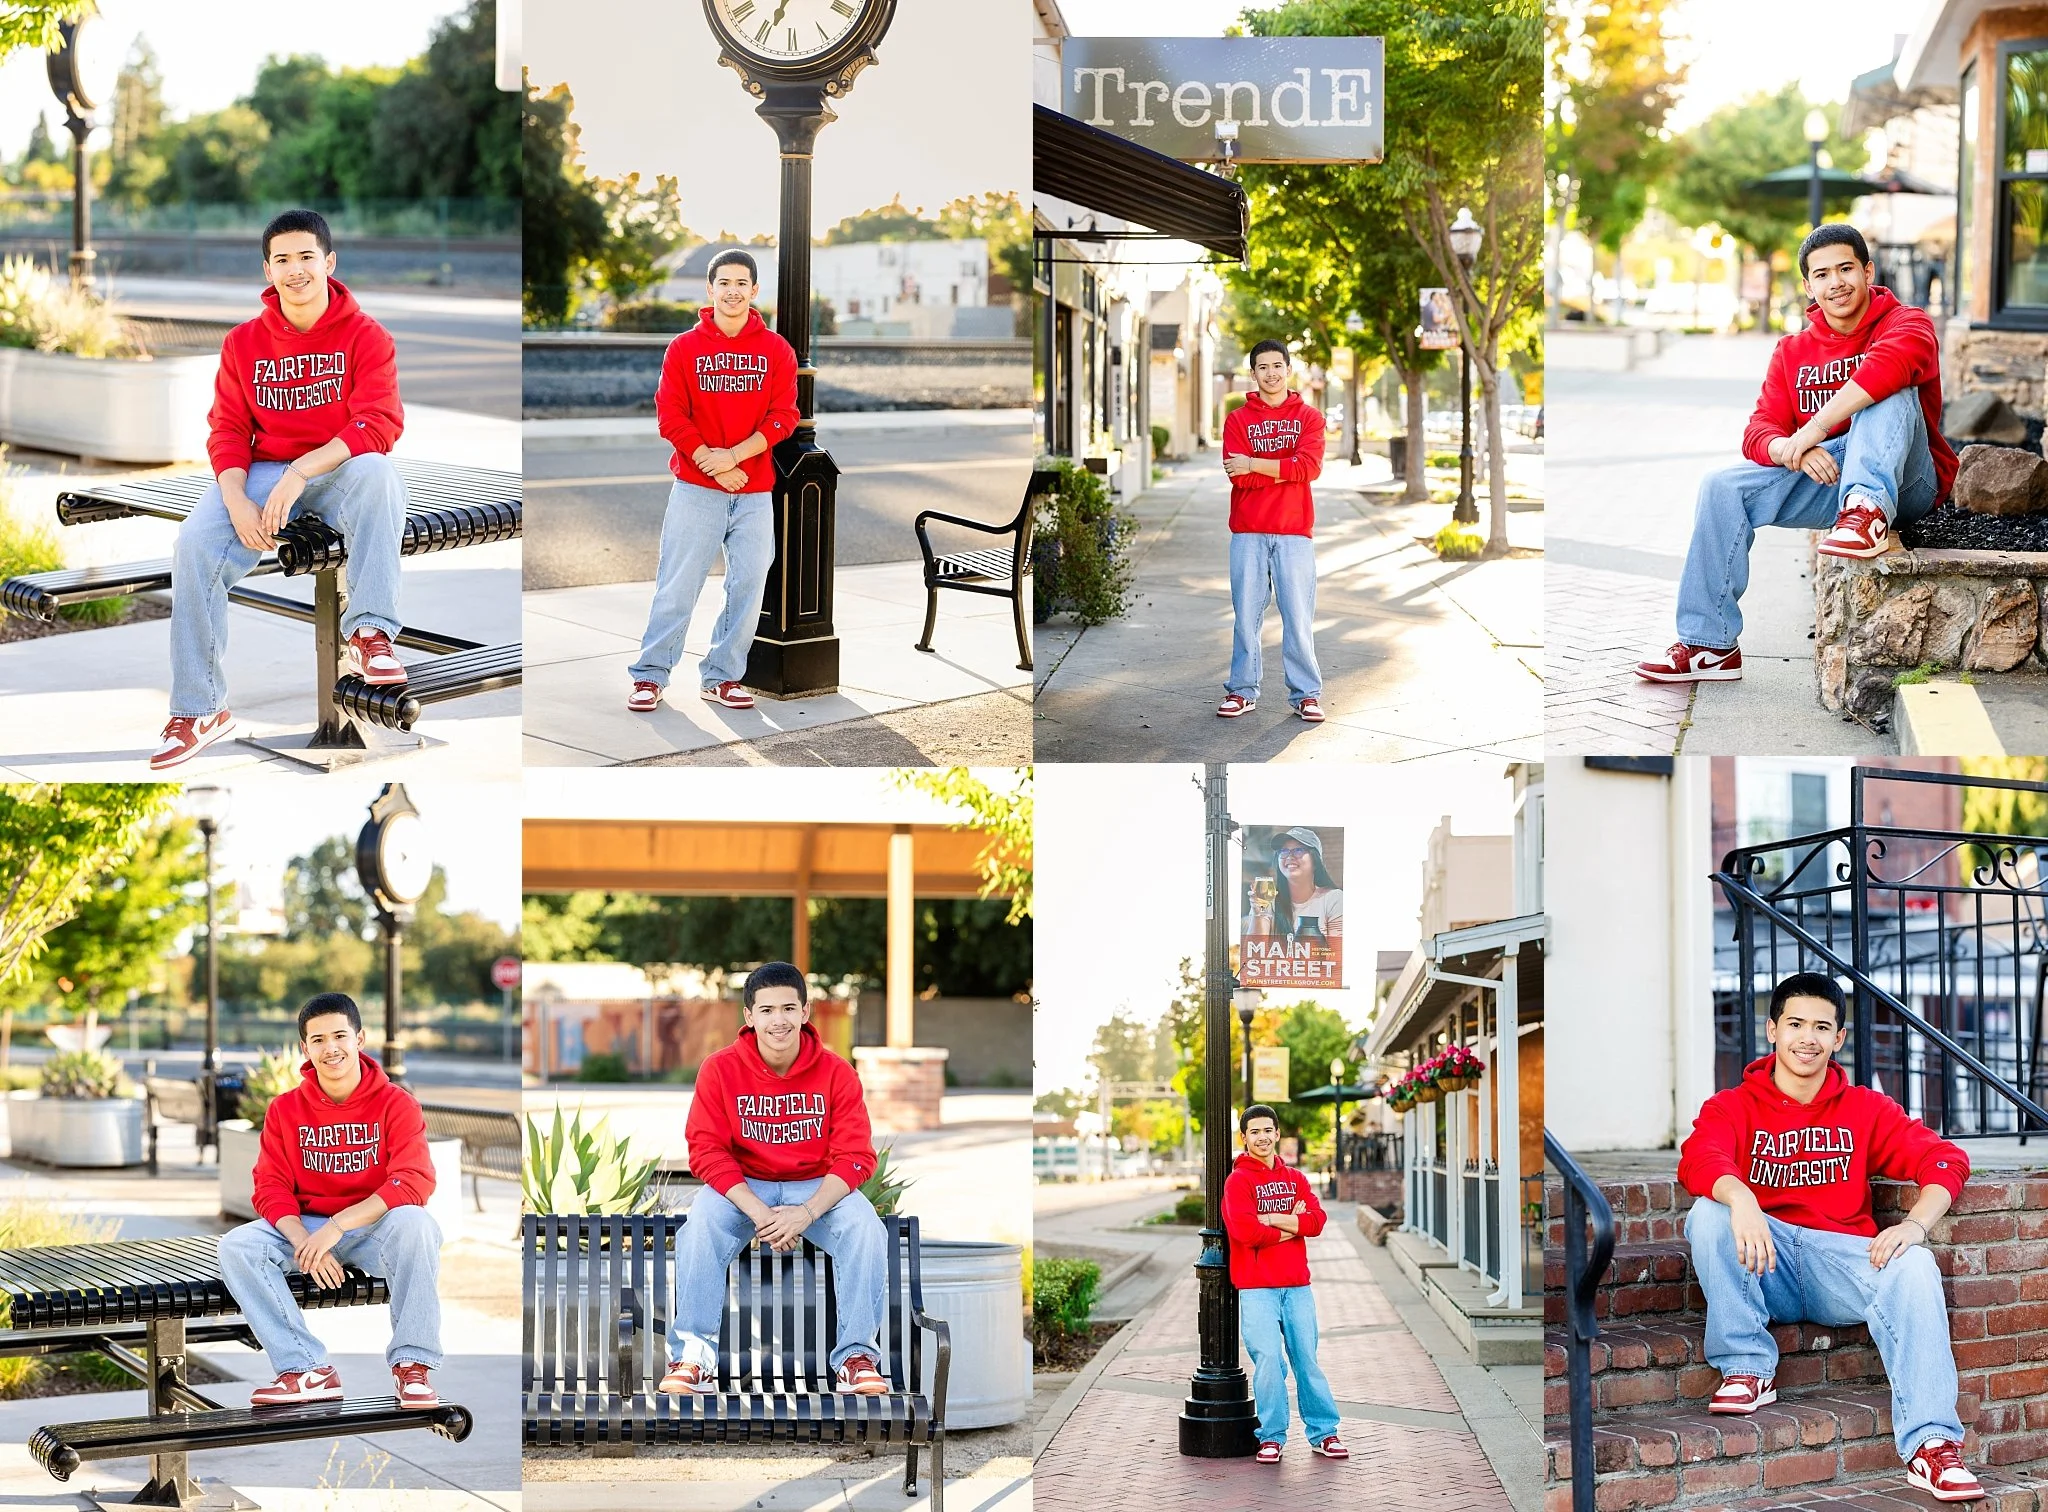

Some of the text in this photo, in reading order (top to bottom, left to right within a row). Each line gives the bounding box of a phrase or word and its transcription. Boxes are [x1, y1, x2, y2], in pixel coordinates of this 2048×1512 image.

[1074, 67, 1372, 128] TrendE
[252, 351, 345, 384] FAIRFIELD
[695, 352, 768, 374] FAIRFIELD
[255, 376, 343, 411] UNIVERSITY
[1247, 940, 1311, 959] MAIN
[1246, 959, 1337, 978] STREET
[1246, 978, 1335, 986] MAINSTREETELKGROVE.COM
[737, 1093, 826, 1117] FAIRFIELD
[298, 1122, 380, 1148] FAIRFIELD
[740, 1117, 824, 1144] UNIVERSITY
[302, 1144, 379, 1173] UNIVERSITY
[1749, 1156, 1851, 1188] UNIVERSITY
